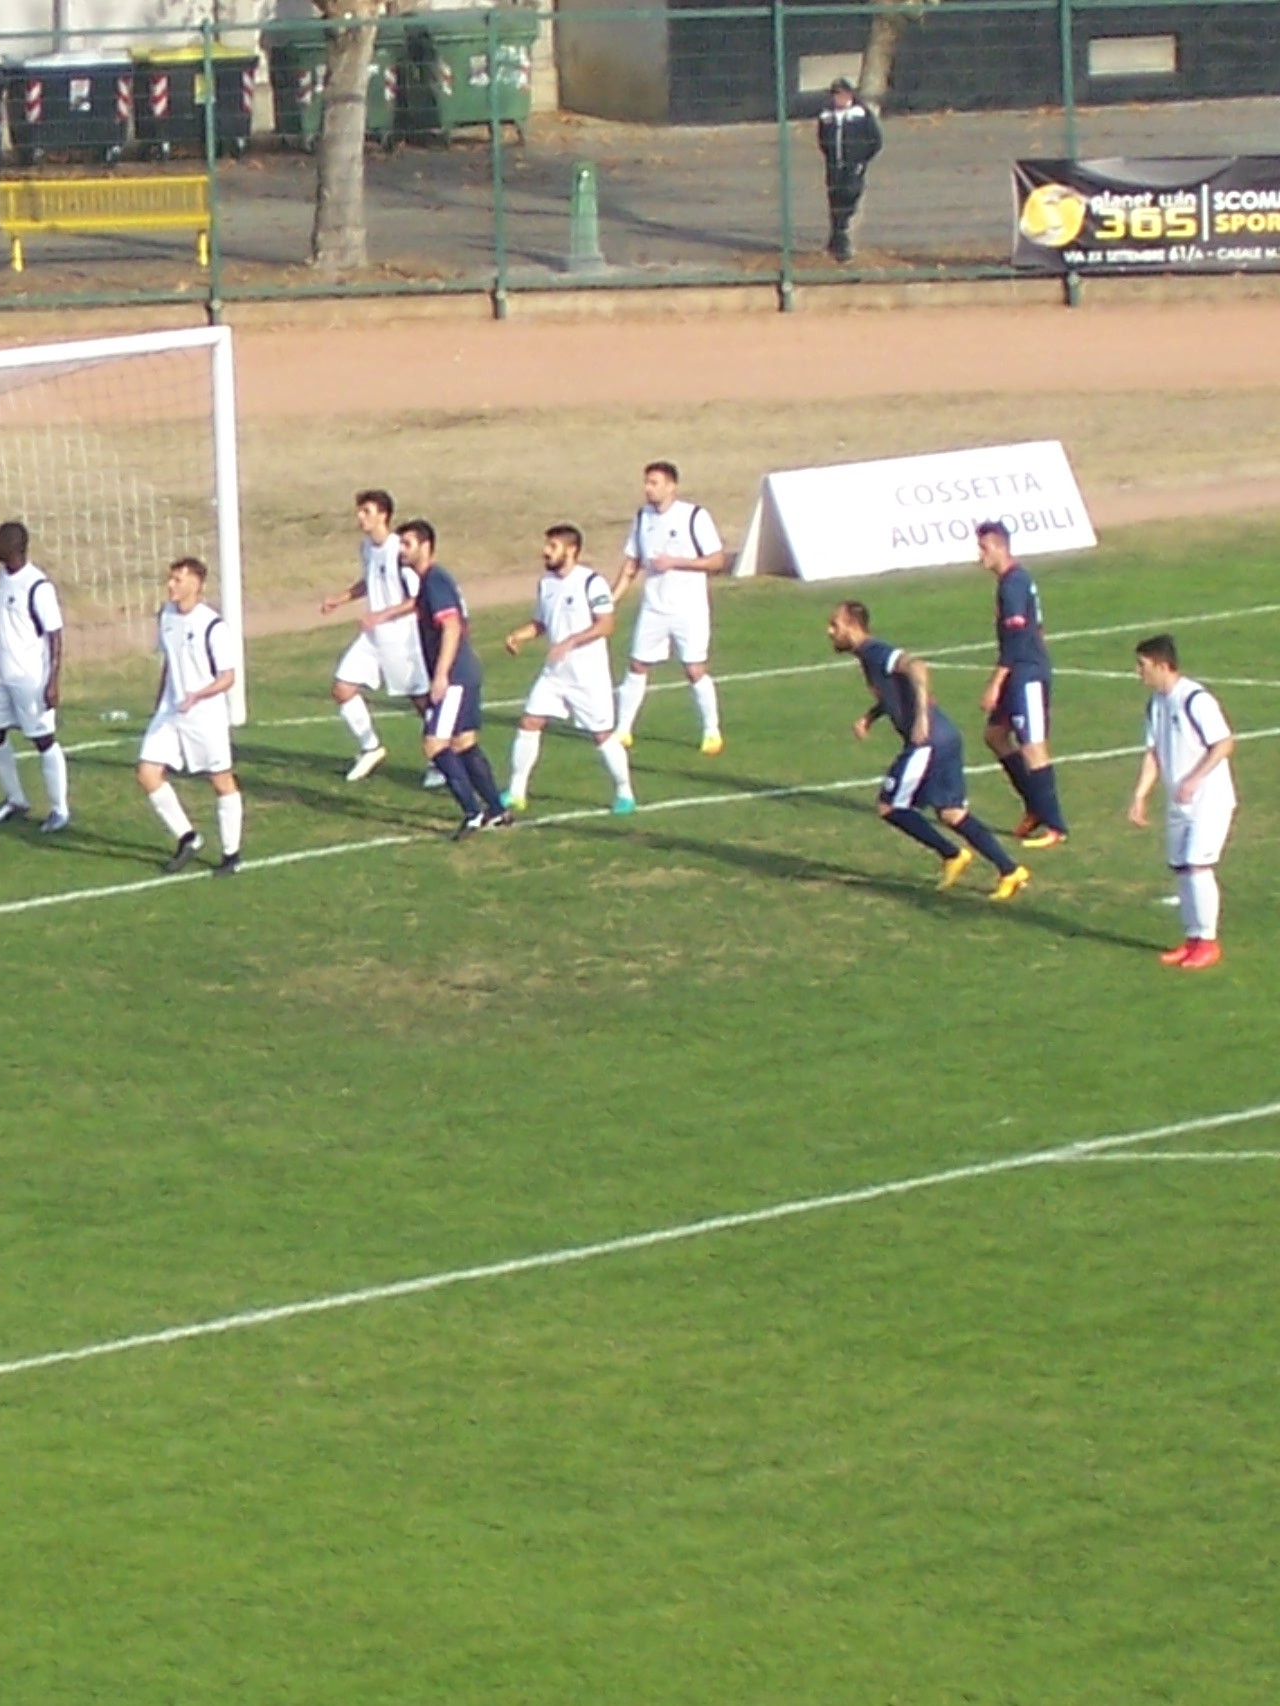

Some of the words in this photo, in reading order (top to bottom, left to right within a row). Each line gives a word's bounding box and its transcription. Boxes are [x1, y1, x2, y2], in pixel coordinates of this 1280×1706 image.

[1091, 189, 1153, 215] planet
[1159, 189, 1196, 208] win
[1095, 207, 1197, 239] 365
[1063, 250, 1085, 263] VIA
[1217, 247, 1262, 260] CASALE
[895, 472, 1042, 506] COSSETTA
